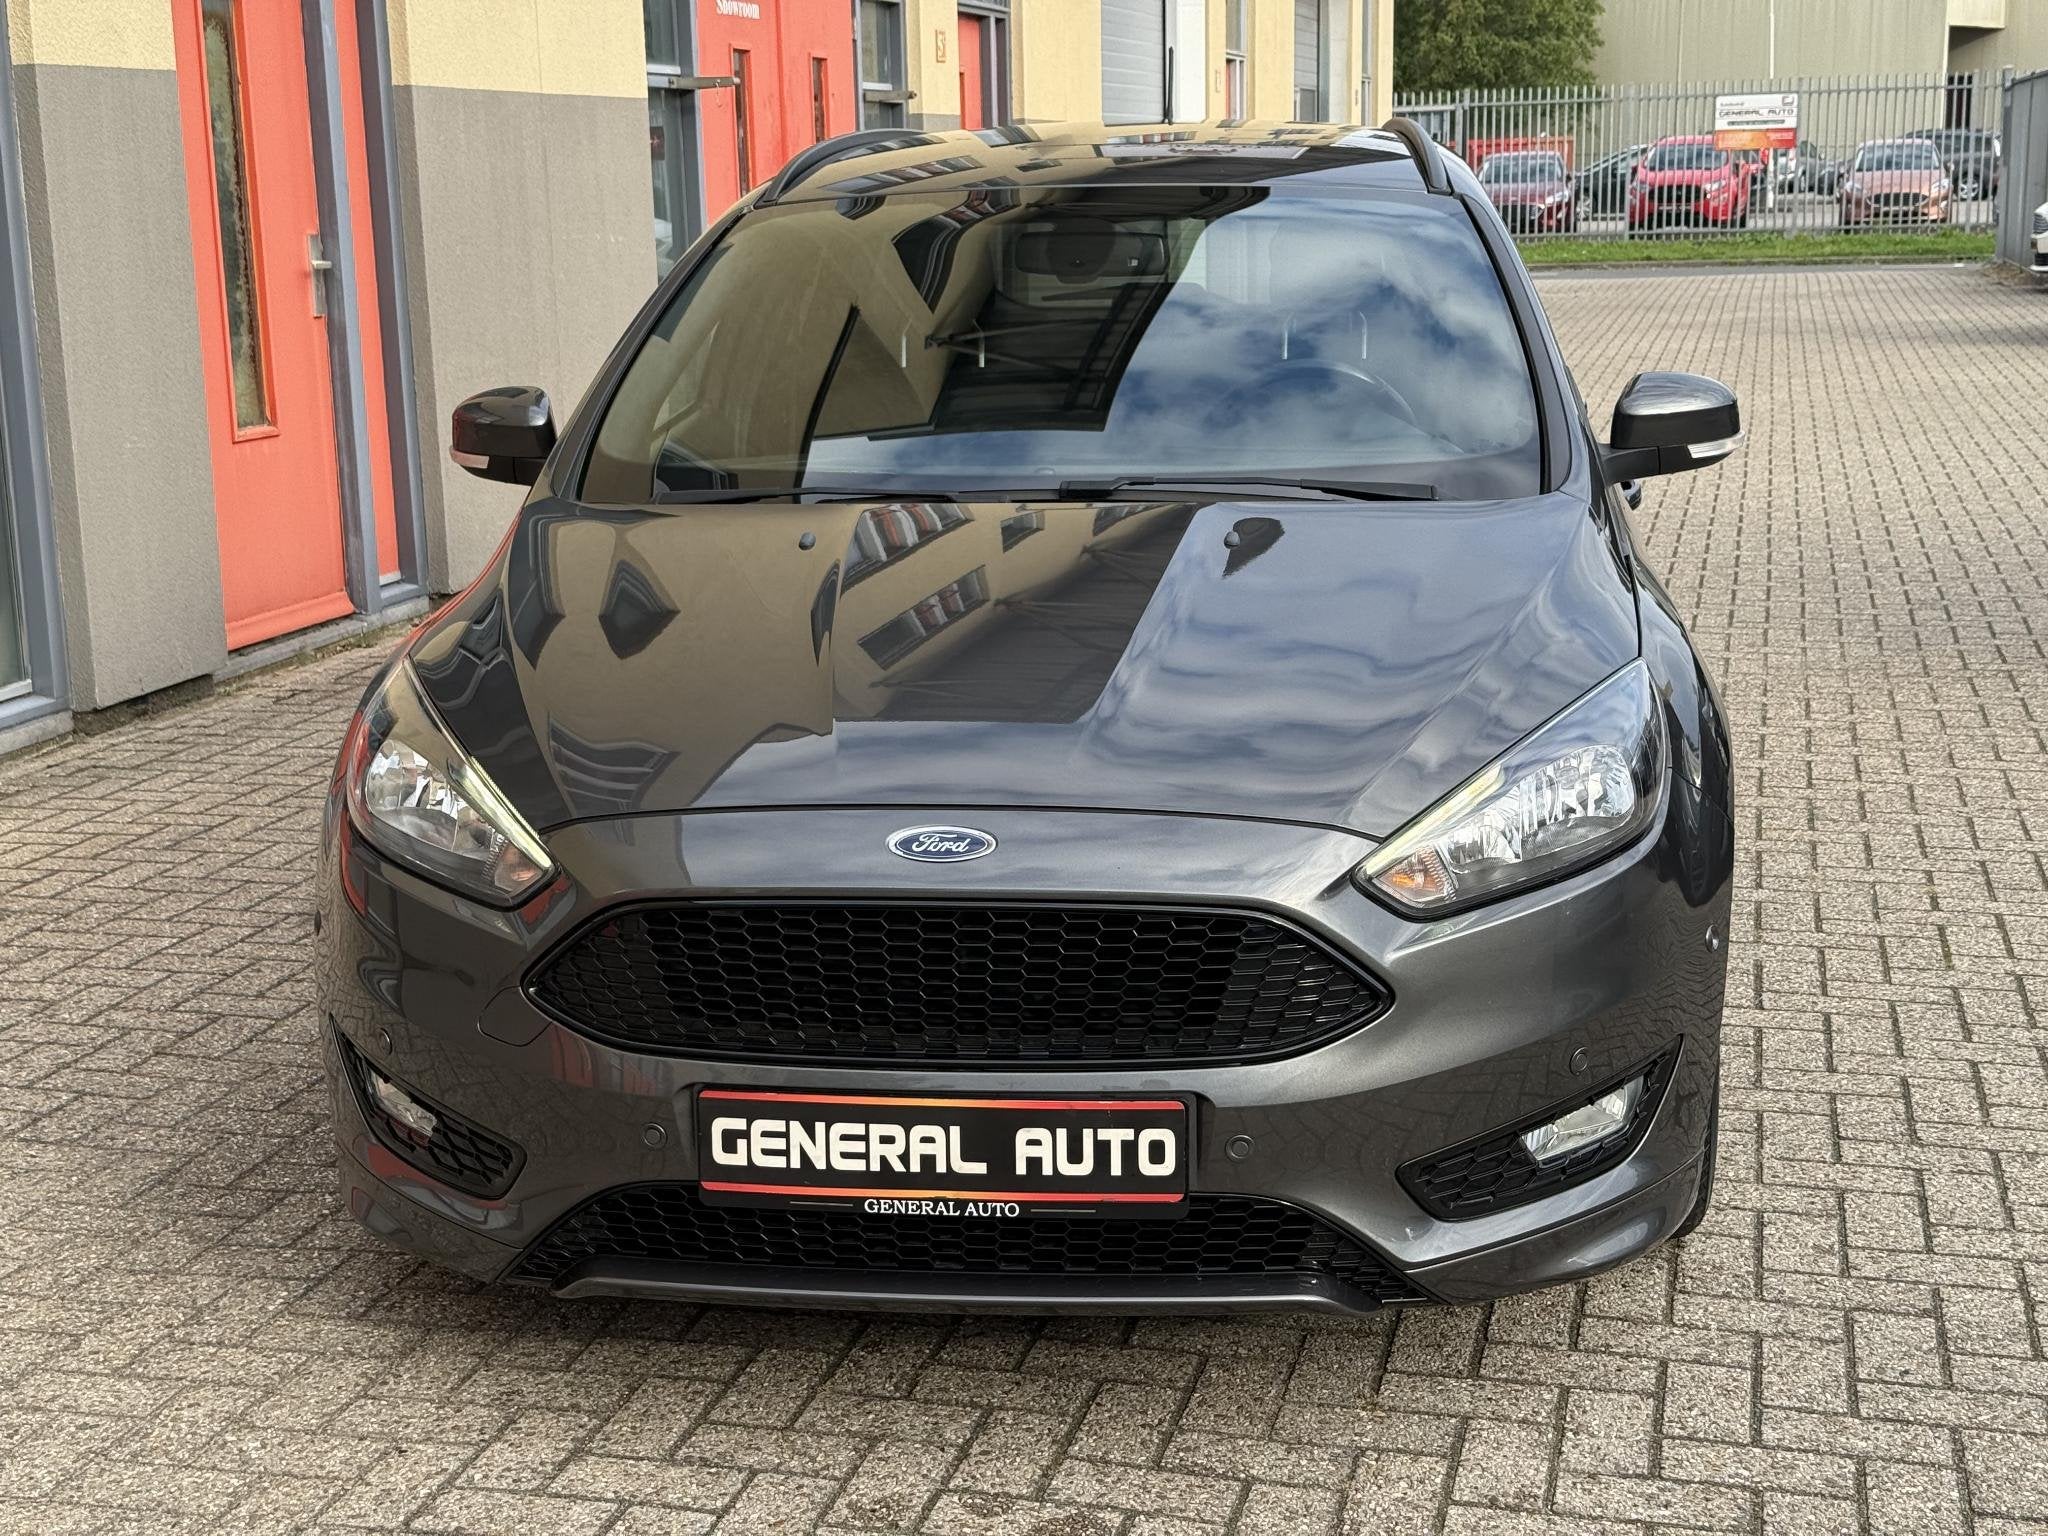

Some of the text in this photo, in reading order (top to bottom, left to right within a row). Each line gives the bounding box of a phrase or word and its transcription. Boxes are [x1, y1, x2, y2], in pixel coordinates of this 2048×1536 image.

[1719, 107, 1794, 118] GENERAL AUTO
[911, 833, 971, 853] Ford
[711, 1117, 1177, 1177] GENERAL AUTO
[864, 1199, 1020, 1217] GENERAL AUTO
